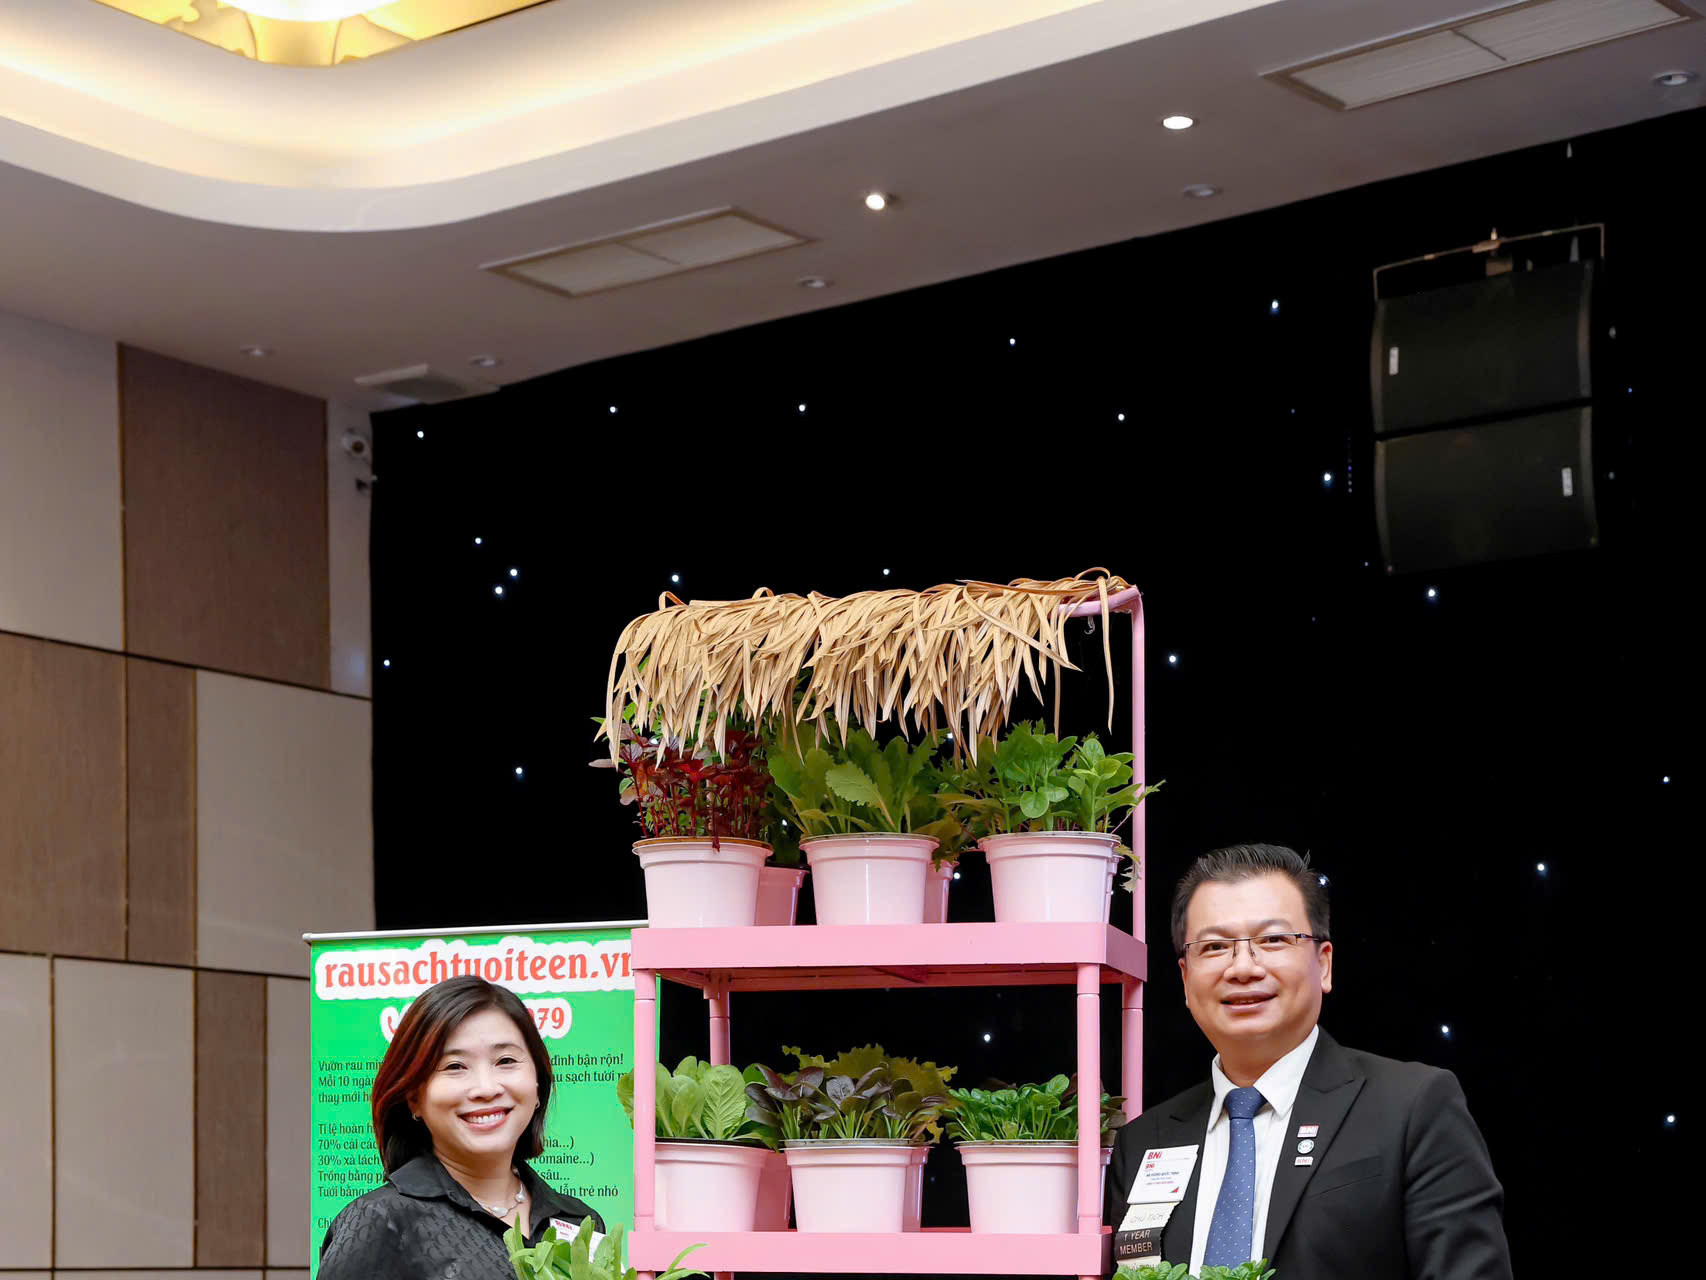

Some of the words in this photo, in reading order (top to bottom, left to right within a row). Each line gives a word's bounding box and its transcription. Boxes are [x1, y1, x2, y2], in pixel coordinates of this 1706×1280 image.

[345, 1062, 363, 1071] rau
[338, 1075, 350, 1087] 10
[565, 1071, 591, 1084] sạch
[319, 1092, 340, 1105] thay
[342, 1091, 361, 1103] mới
[339, 1122, 364, 1134] hoàn
[319, 1139, 342, 1150] 70%
[319, 1155, 342, 1166] 30%
[358, 1154, 380, 1166] lách
[1130, 1229, 1151, 1241] YEAR
[1119, 1241, 1153, 1256] MEMBER
